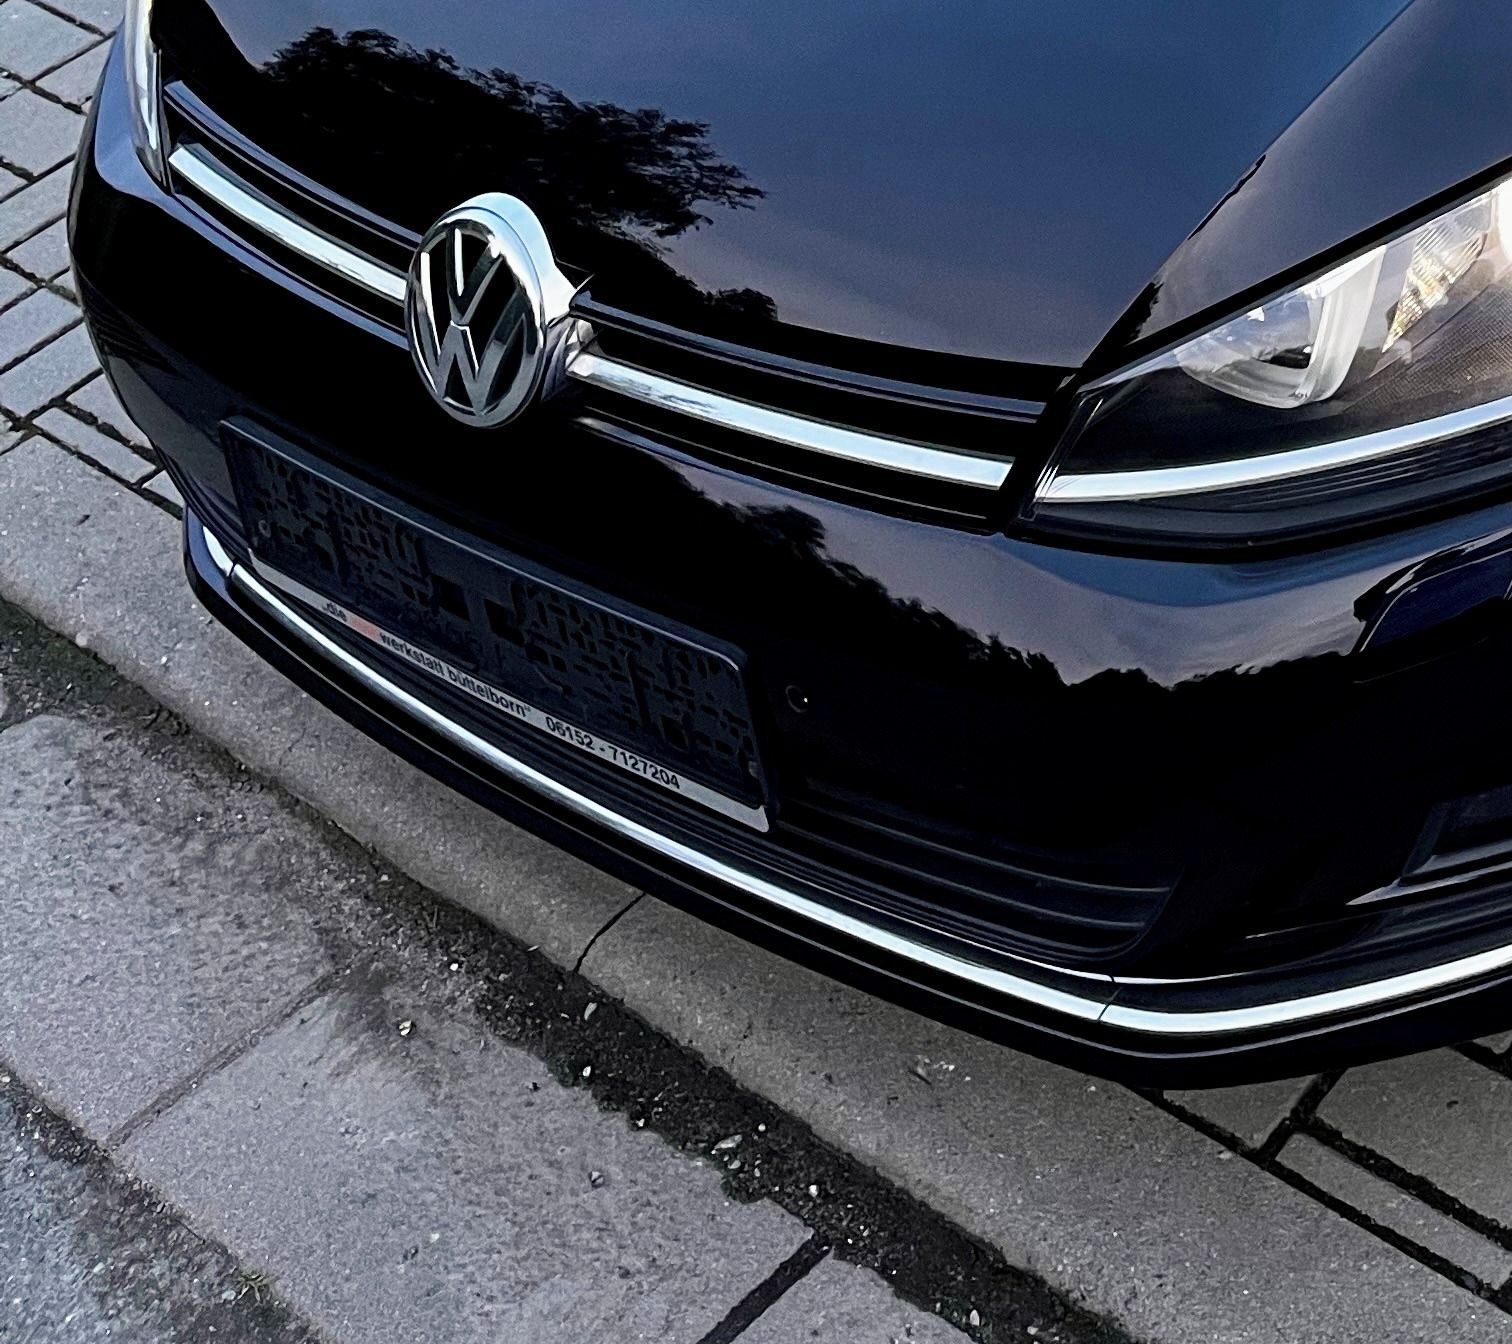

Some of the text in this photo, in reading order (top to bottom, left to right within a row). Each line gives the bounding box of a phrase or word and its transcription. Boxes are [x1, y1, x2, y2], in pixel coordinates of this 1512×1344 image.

[379, 631, 445, 677] werkstatt
[545, 716, 595, 751] 06152
[608, 744, 681, 789] 7127204
